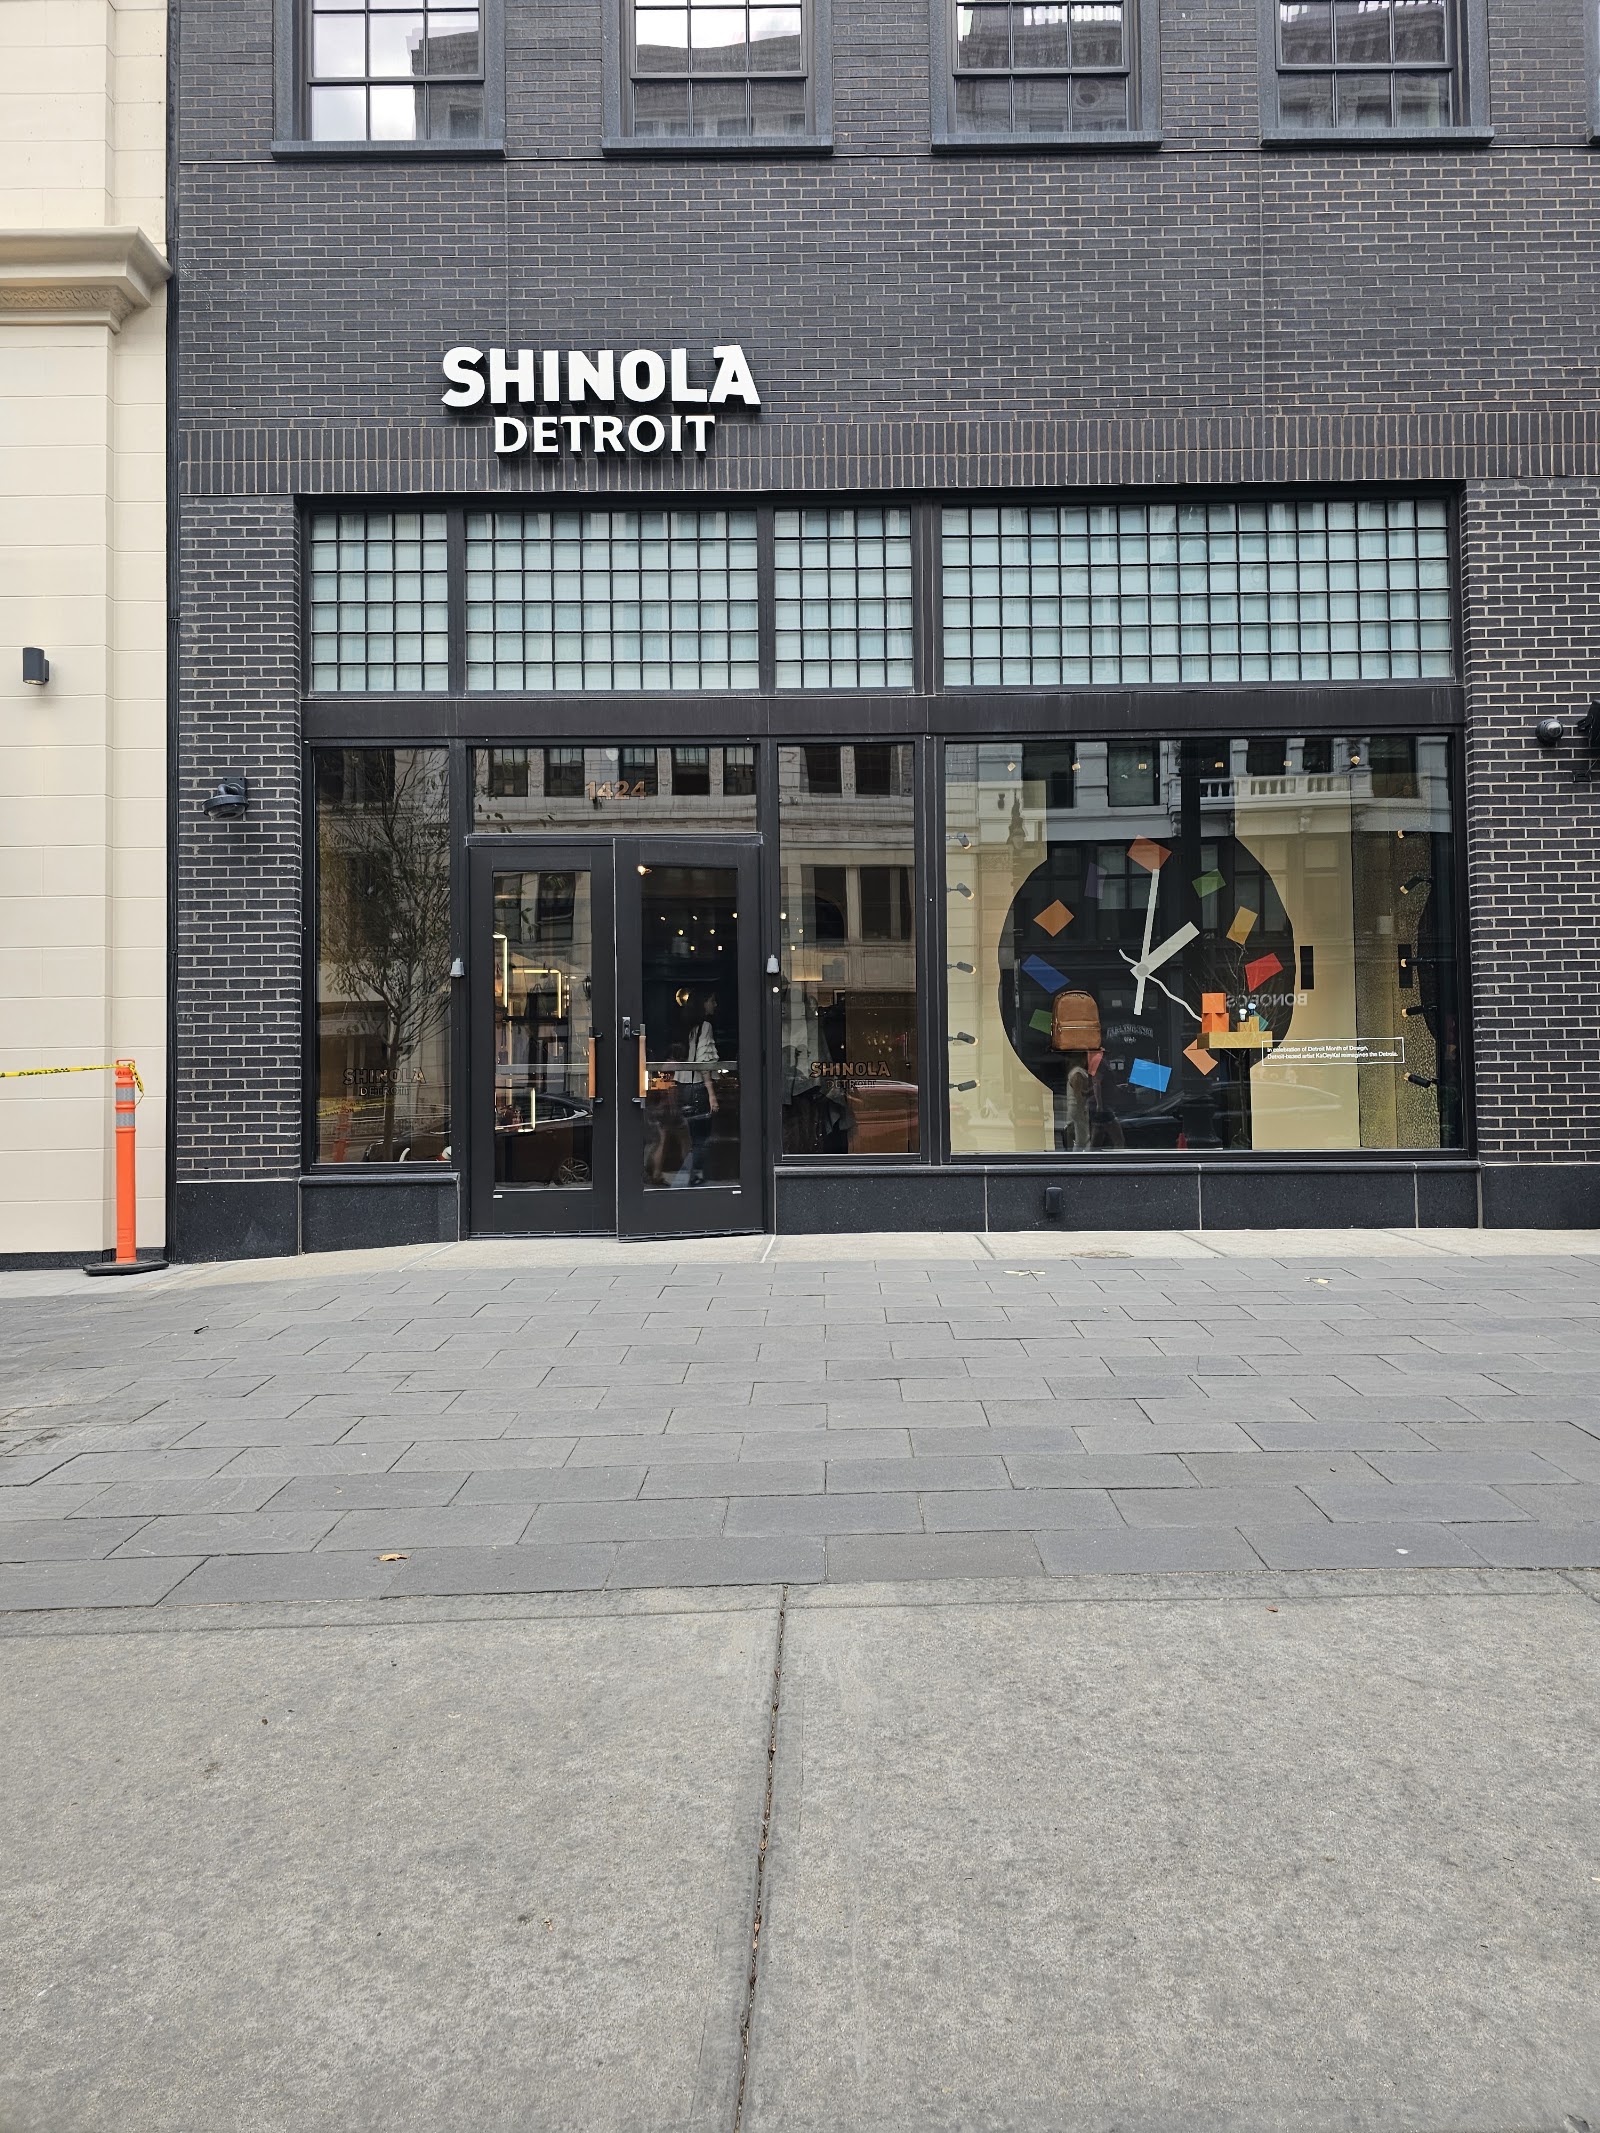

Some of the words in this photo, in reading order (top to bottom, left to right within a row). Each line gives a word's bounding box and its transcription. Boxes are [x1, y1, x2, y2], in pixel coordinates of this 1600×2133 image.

[441, 345, 762, 408] SHINOLA
[493, 415, 716, 453] DETROIT
[585, 780, 647, 800] 1424
[343, 1066, 427, 1085] SHINOLA
[810, 1061, 891, 1078] SHINOLA
[360, 1086, 410, 1096] DETROIT
